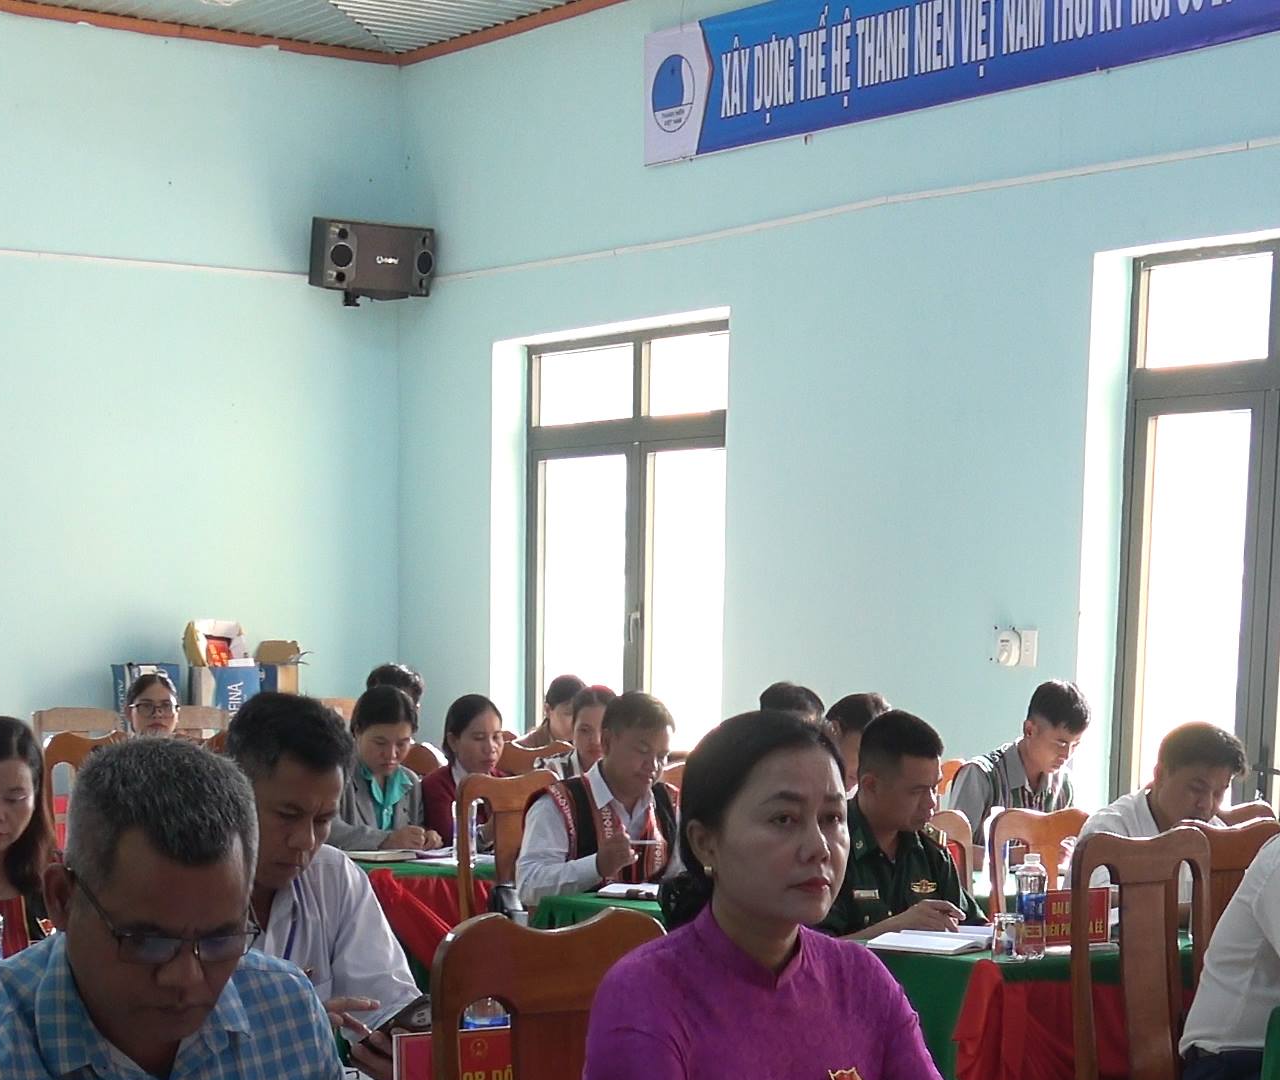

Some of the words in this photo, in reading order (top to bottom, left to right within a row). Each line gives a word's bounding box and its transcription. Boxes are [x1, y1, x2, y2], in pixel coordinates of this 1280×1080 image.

[720, 34, 750, 119] XÂY
[753, 33, 795, 125] DỰNG
[799, 5, 827, 102] THẾ
[831, 5, 852, 109] HỆ
[855, 7, 910, 89] THANH
